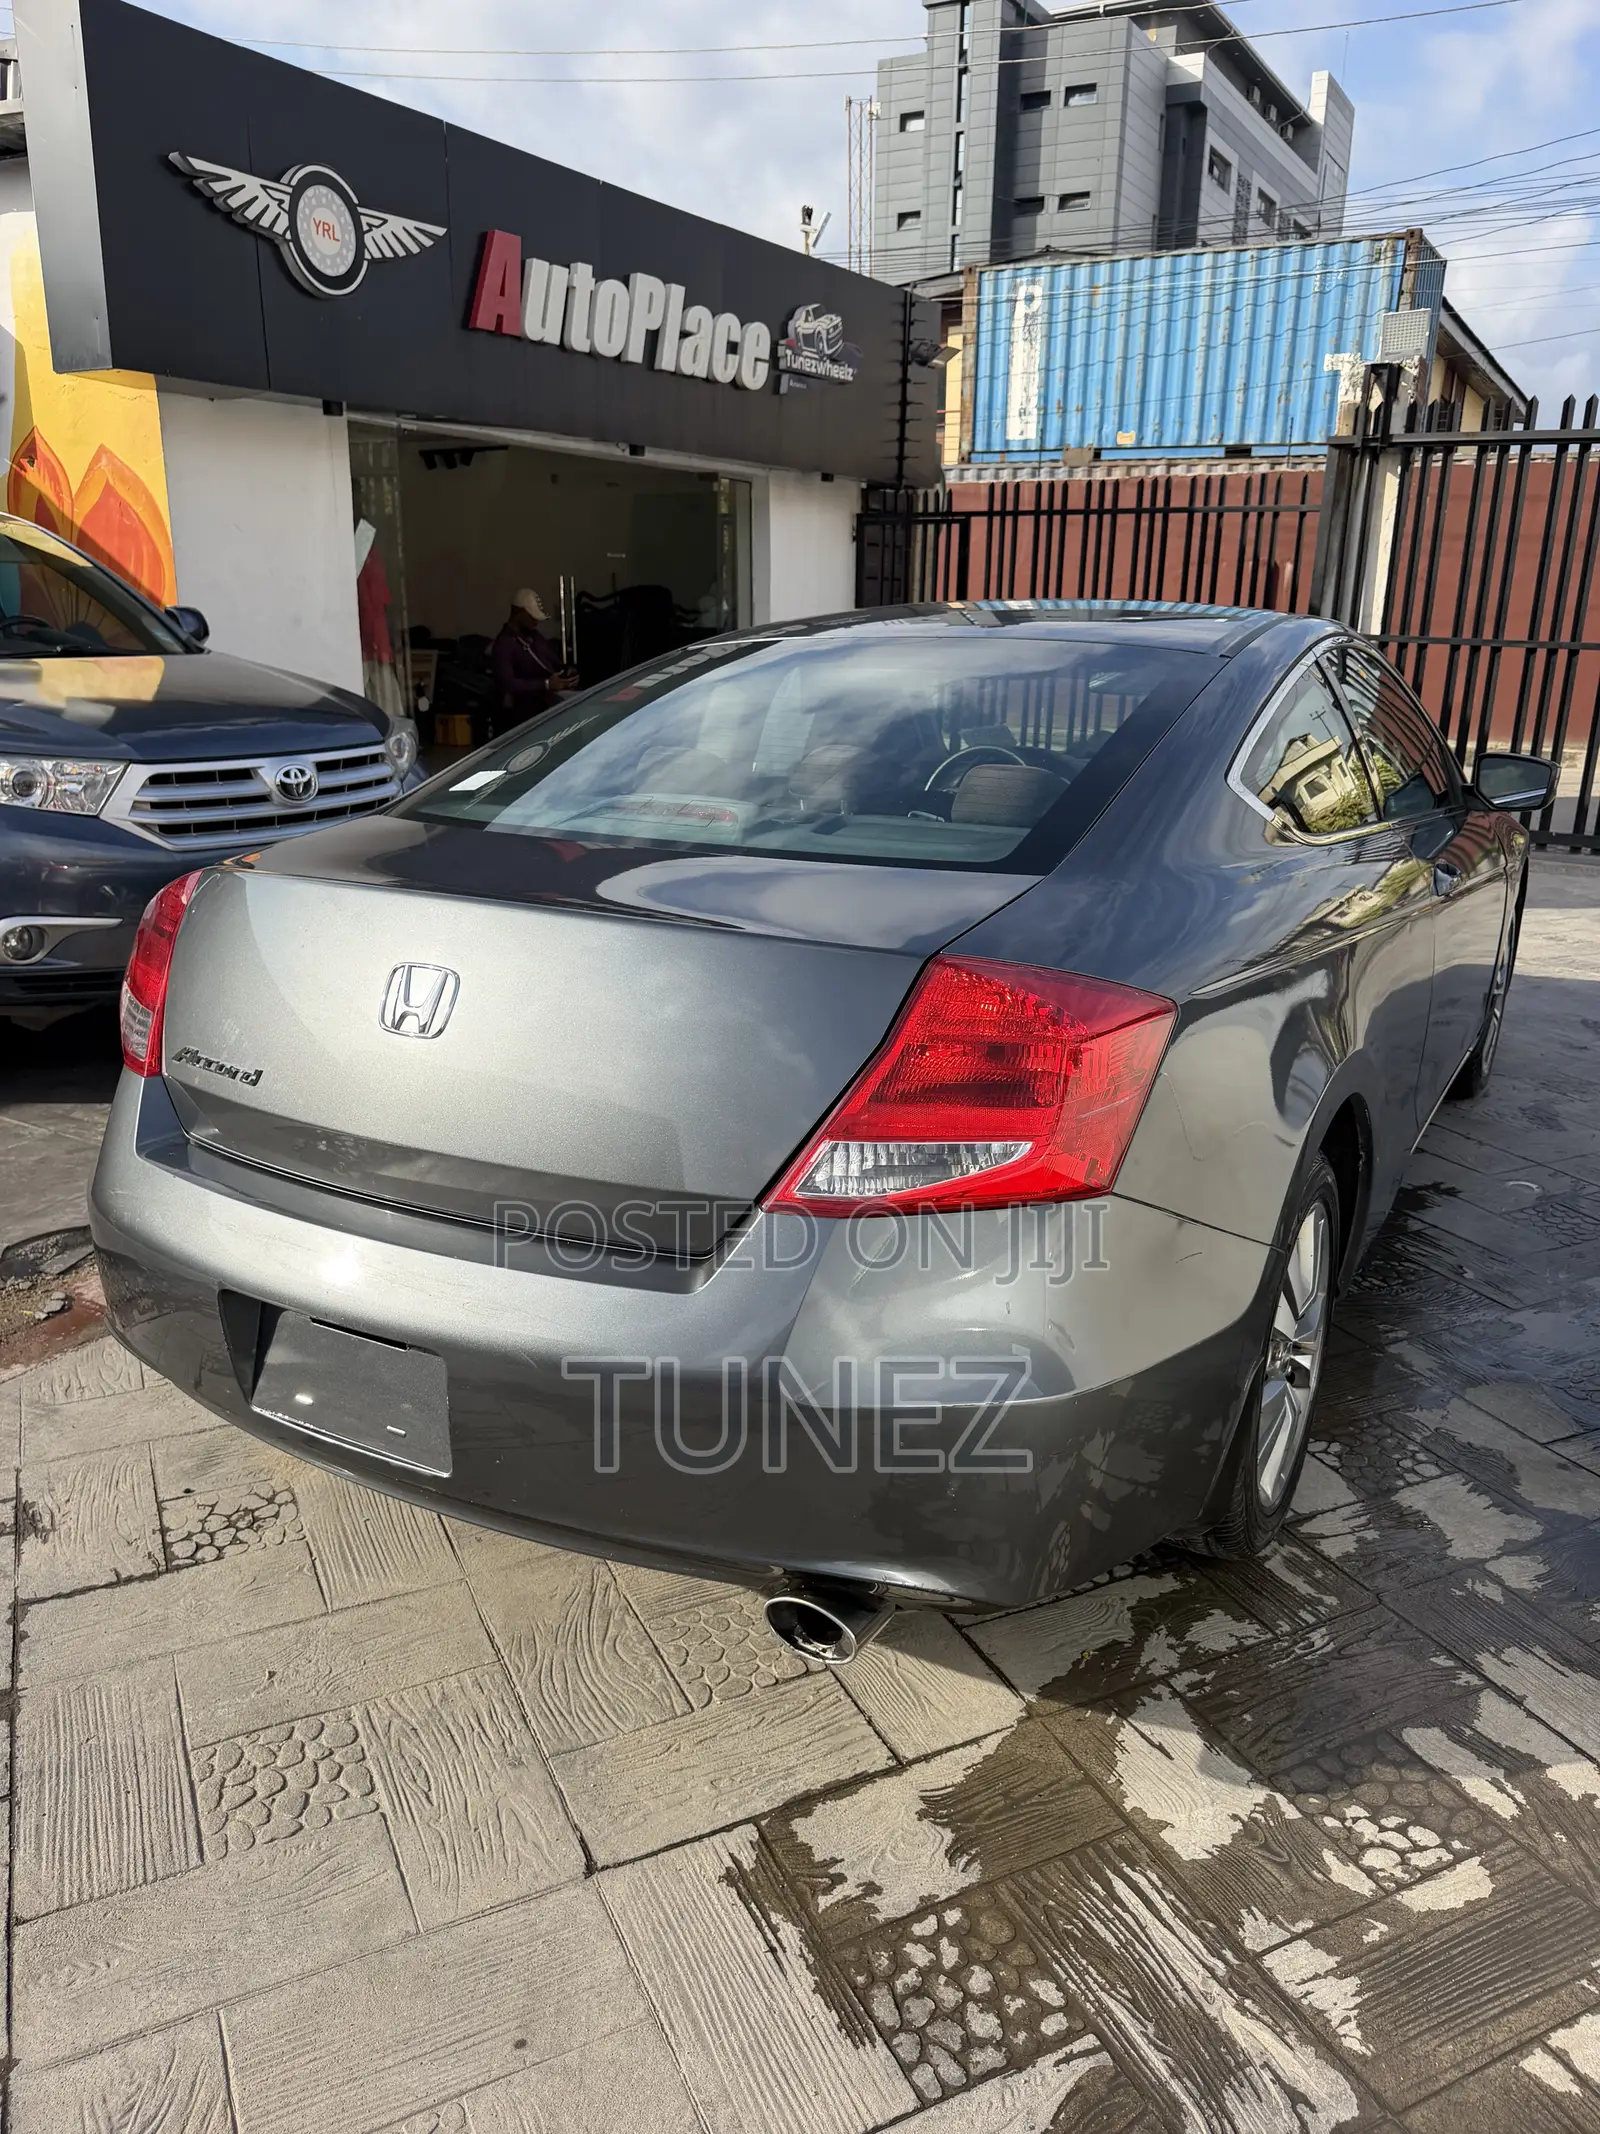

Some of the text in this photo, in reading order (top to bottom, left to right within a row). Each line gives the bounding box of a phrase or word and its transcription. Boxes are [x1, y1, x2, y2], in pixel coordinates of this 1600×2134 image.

[312, 216, 341, 243] YRL
[469, 229, 771, 391] AutoPlace
[171, 1046, 264, 1087] Accord
